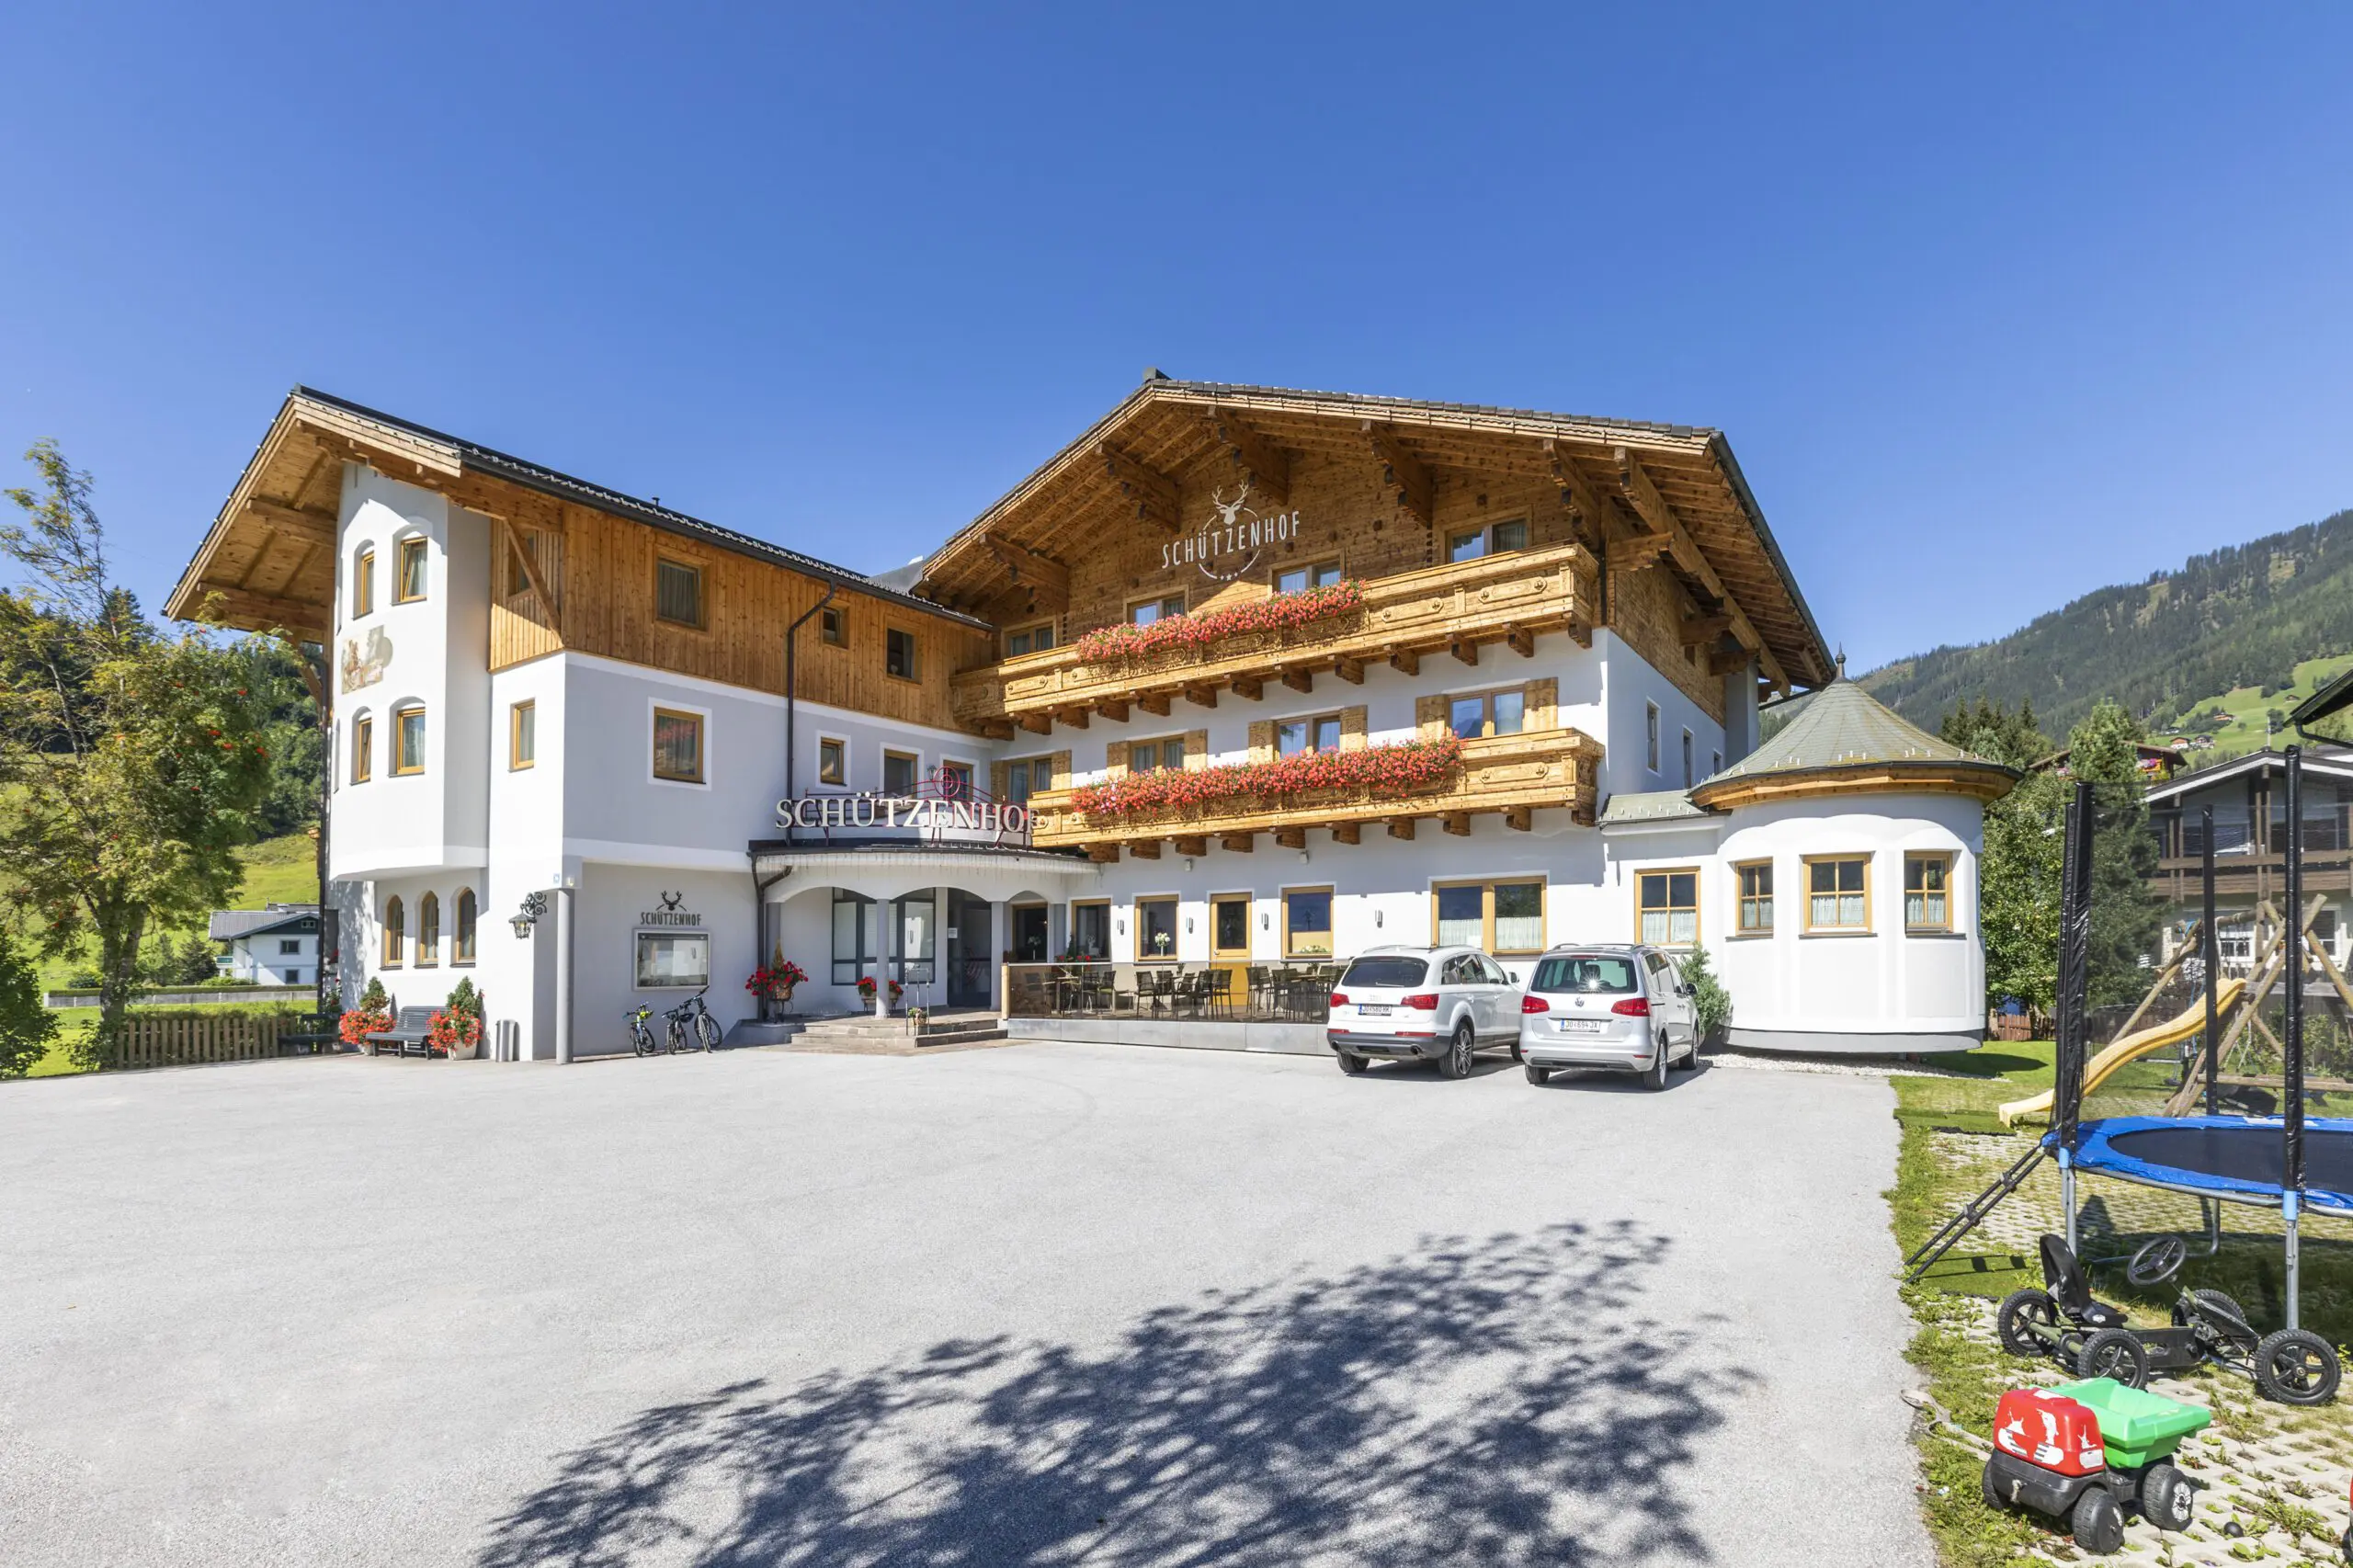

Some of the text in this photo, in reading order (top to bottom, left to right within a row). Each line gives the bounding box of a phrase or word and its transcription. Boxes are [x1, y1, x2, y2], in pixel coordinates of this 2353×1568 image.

[1162, 510, 1300, 569] SCHÜTZENHOF
[776, 791, 1040, 834] SCHÜTZENHOF
[641, 911, 702, 926] SCHÜTZENHOF
